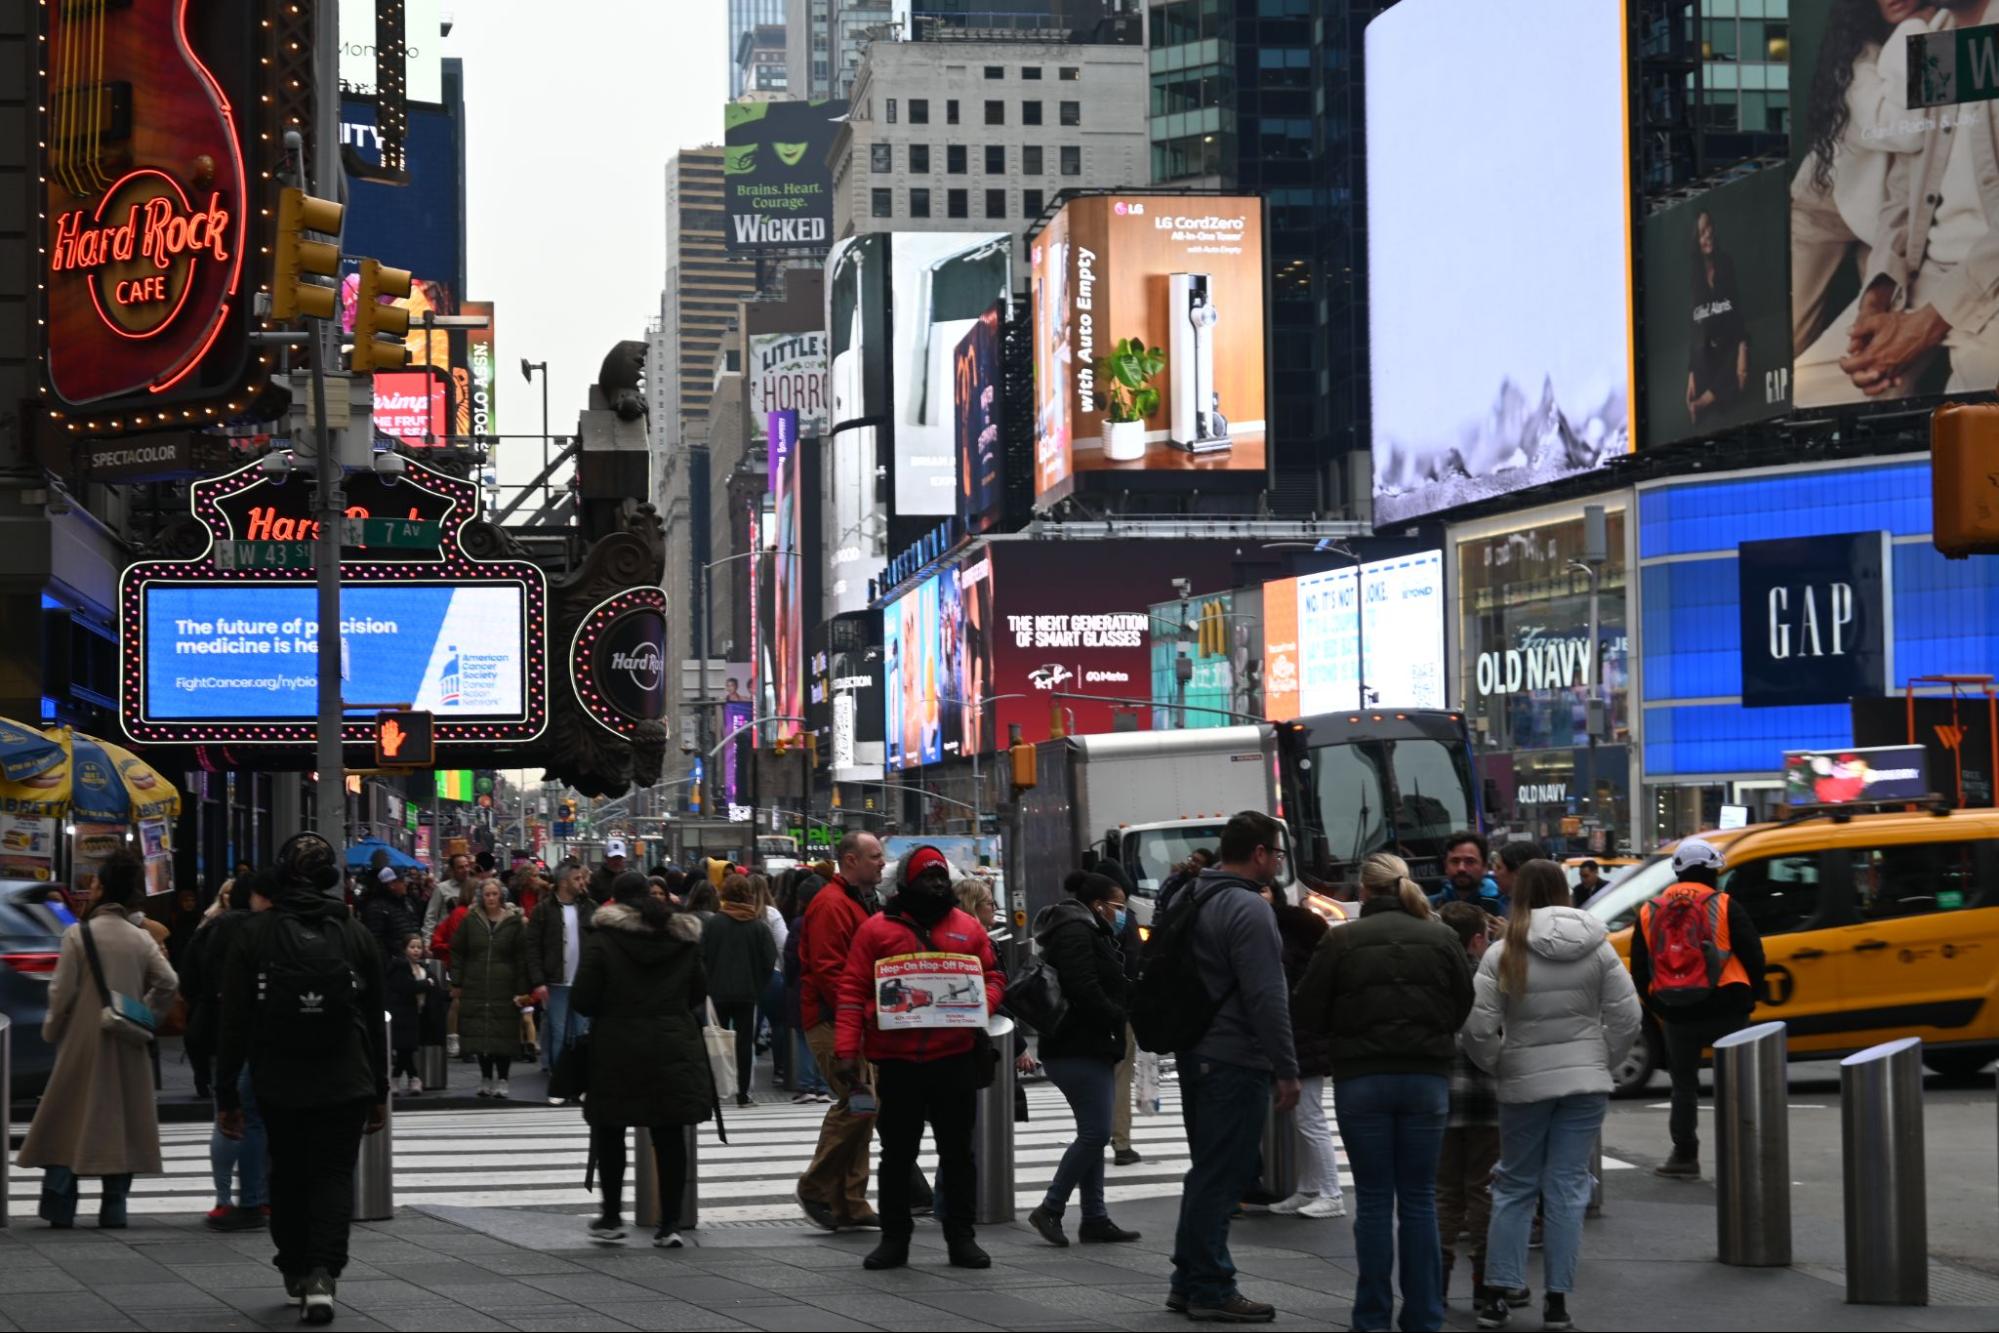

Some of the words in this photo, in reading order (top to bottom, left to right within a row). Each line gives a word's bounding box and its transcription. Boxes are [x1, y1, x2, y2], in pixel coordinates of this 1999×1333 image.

[737, 184, 781, 196] Brains.
[784, 182, 823, 195] Heart.
[752, 197, 808, 210] Courage.
[1128, 203, 1144, 215] LG
[52, 205, 139, 271] Hard
[142, 191, 229, 270] Rock
[1155, 216, 1173, 230] LG
[1075, 246, 1096, 309] Empty
[115, 276, 166, 305] CAFE
[1078, 311, 1093, 363] Auto
[763, 336, 818, 371] LITTLE
[473, 341, 488, 387] ASSN.
[1077, 368, 1094, 413] with
[473, 392, 489, 437] POLO
[92, 446, 176, 468] SPECTACOLOR
[385, 523, 394, 543] 7
[403, 524, 421, 537] Av
[239, 546, 255, 565] W
[265, 545, 287, 565] 43
[175, 619, 213, 635] The
[216, 618, 278, 635] future
[281, 618, 302, 635] of
[305, 617, 398, 639] pcision
[1007, 615, 1033, 632] THE
[1035, 615, 1069, 631] NEXT
[1071, 614, 1149, 631] GENERATION
[1769, 582, 1852, 659] GAP
[176, 637, 271, 654] medicine
[273, 637, 291, 654] is
[1016, 632, 1033, 648] OF
[1035, 632, 1081, 647] SMART
[1083, 631, 1142, 647] GLASSES
[463, 653, 509, 662] American
[463, 663, 497, 671] Cancer
[612, 652, 648, 670] Hard
[463, 672, 497, 680] Society
[1477, 650, 1522, 696] OLD
[1526, 640, 1592, 691] NAVY
[1519, 785, 1544, 803] OLD
[1545, 783, 1567, 802] NAVY
[880, 963, 918, 975] Hop-On
